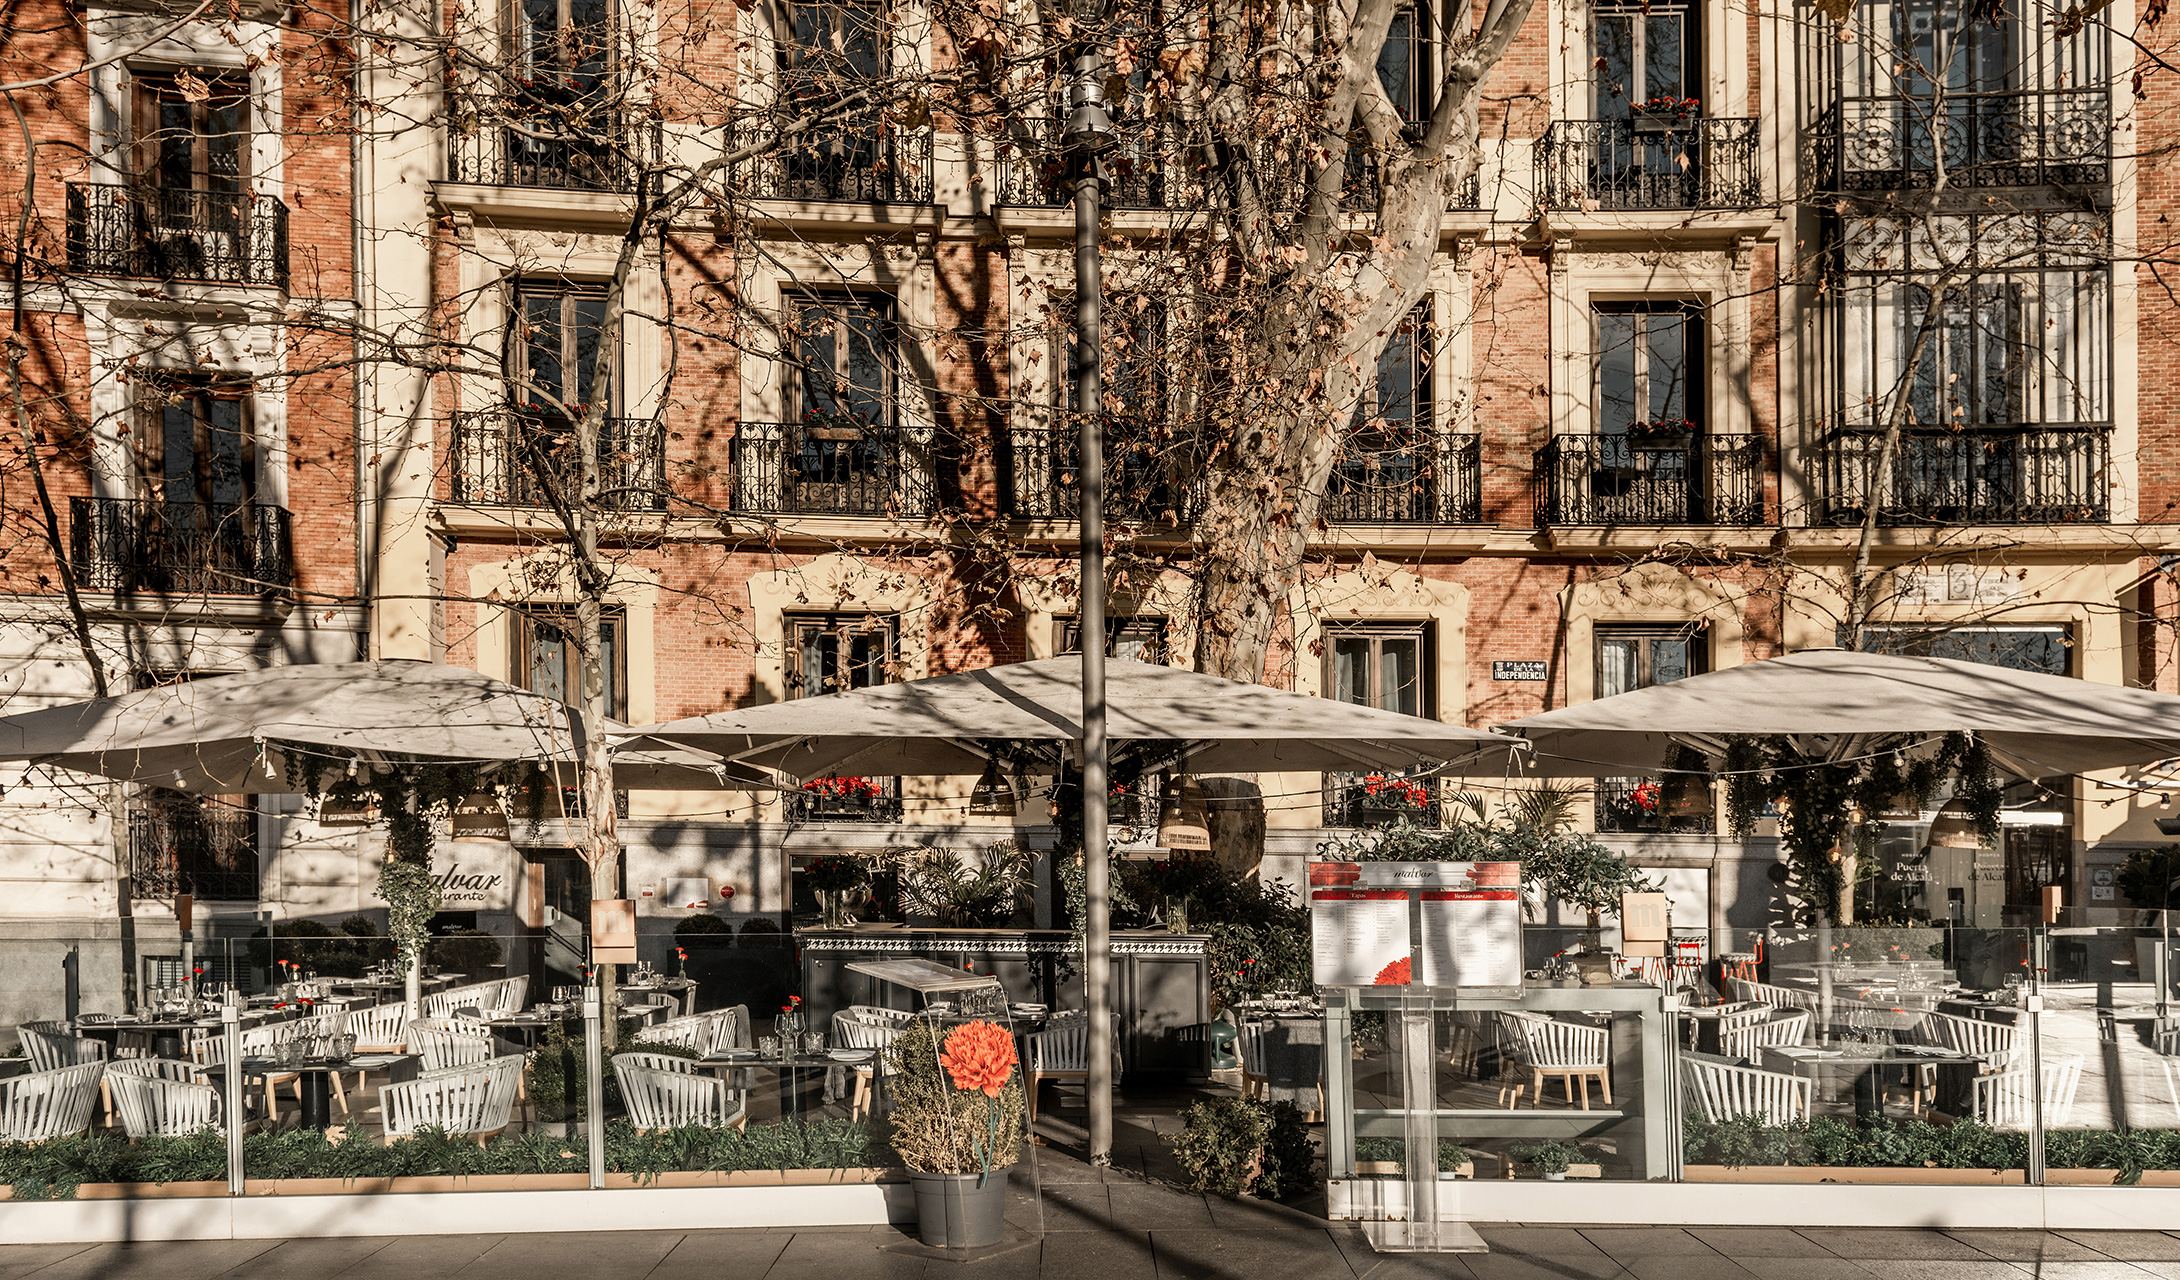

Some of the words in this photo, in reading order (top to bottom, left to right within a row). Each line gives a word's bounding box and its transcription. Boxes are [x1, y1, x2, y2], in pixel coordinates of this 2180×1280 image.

[1953, 571, 1967, 594] 3
[1494, 670, 1546, 679] INDEPENDENCIA
[1896, 861, 1929, 872] Puerta
[430, 863, 502, 890] alvar
[1392, 867, 1434, 879] malvar
[1890, 871, 1904, 881] de
[1904, 871, 1934, 882] Alcalá
[1981, 872, 2006, 881] Alcal
[1628, 903, 1663, 928] m
[596, 910, 629, 934] m
